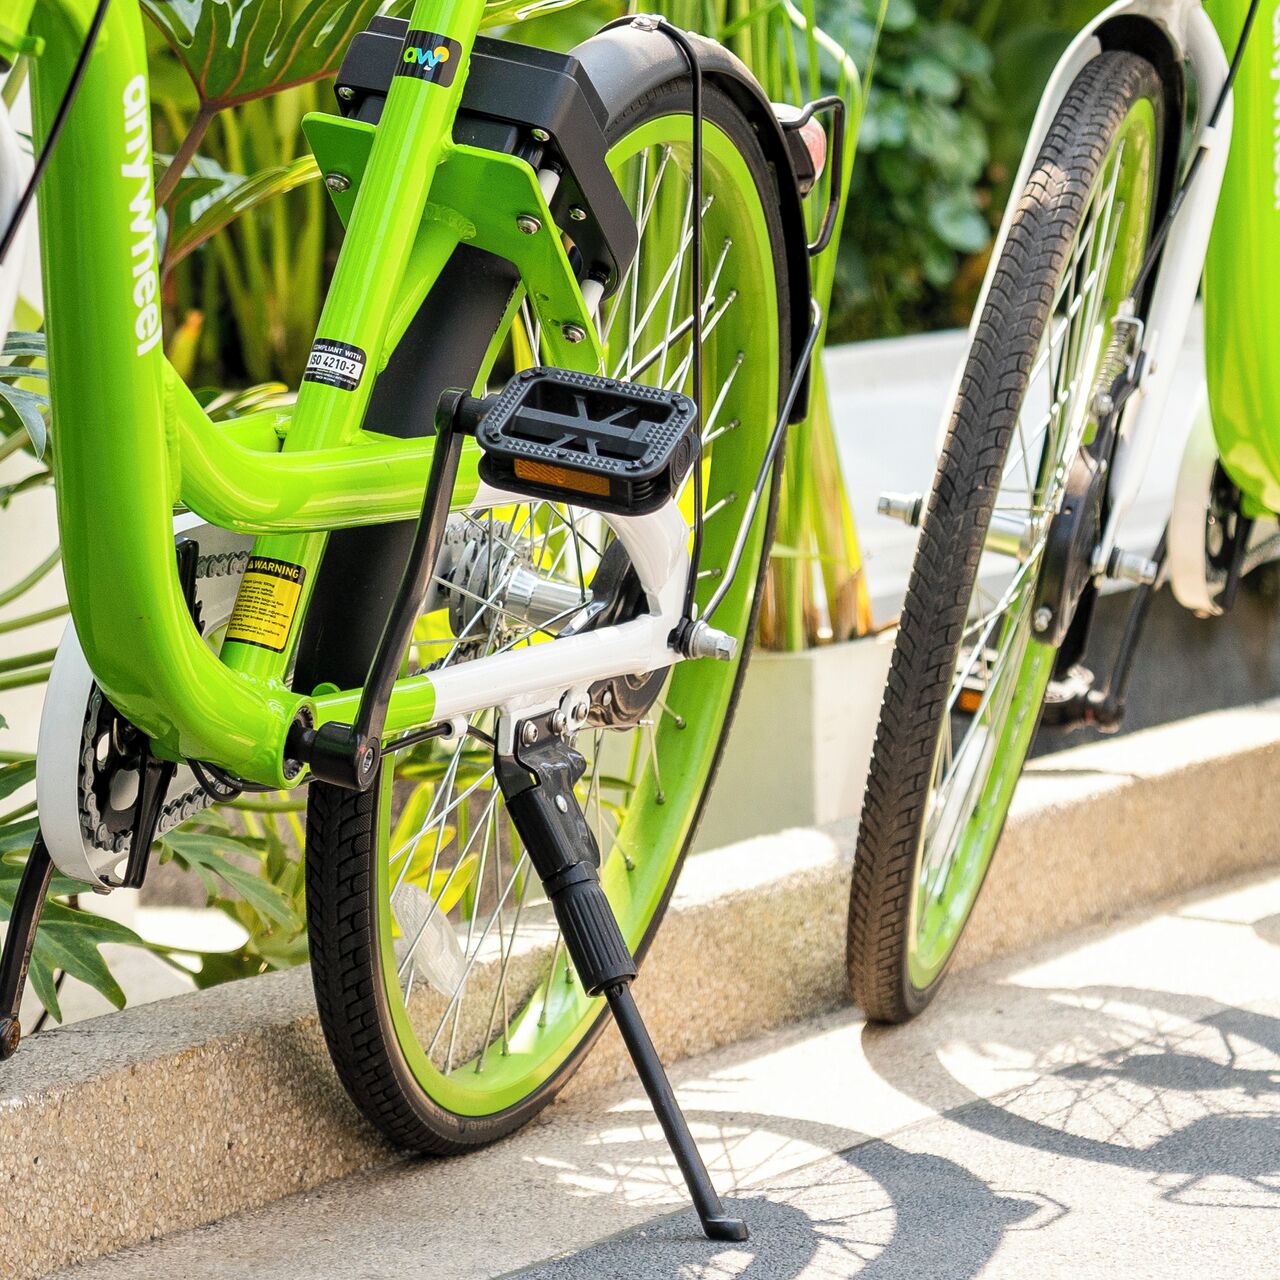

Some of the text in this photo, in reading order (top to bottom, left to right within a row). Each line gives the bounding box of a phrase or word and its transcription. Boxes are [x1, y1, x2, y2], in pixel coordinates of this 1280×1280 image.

[121, 74, 163, 357] anywheel
[310, 353, 356, 375] ISO 4210-2
[345, 349, 362, 361] WITH
[255, 560, 299, 578] WARNING
